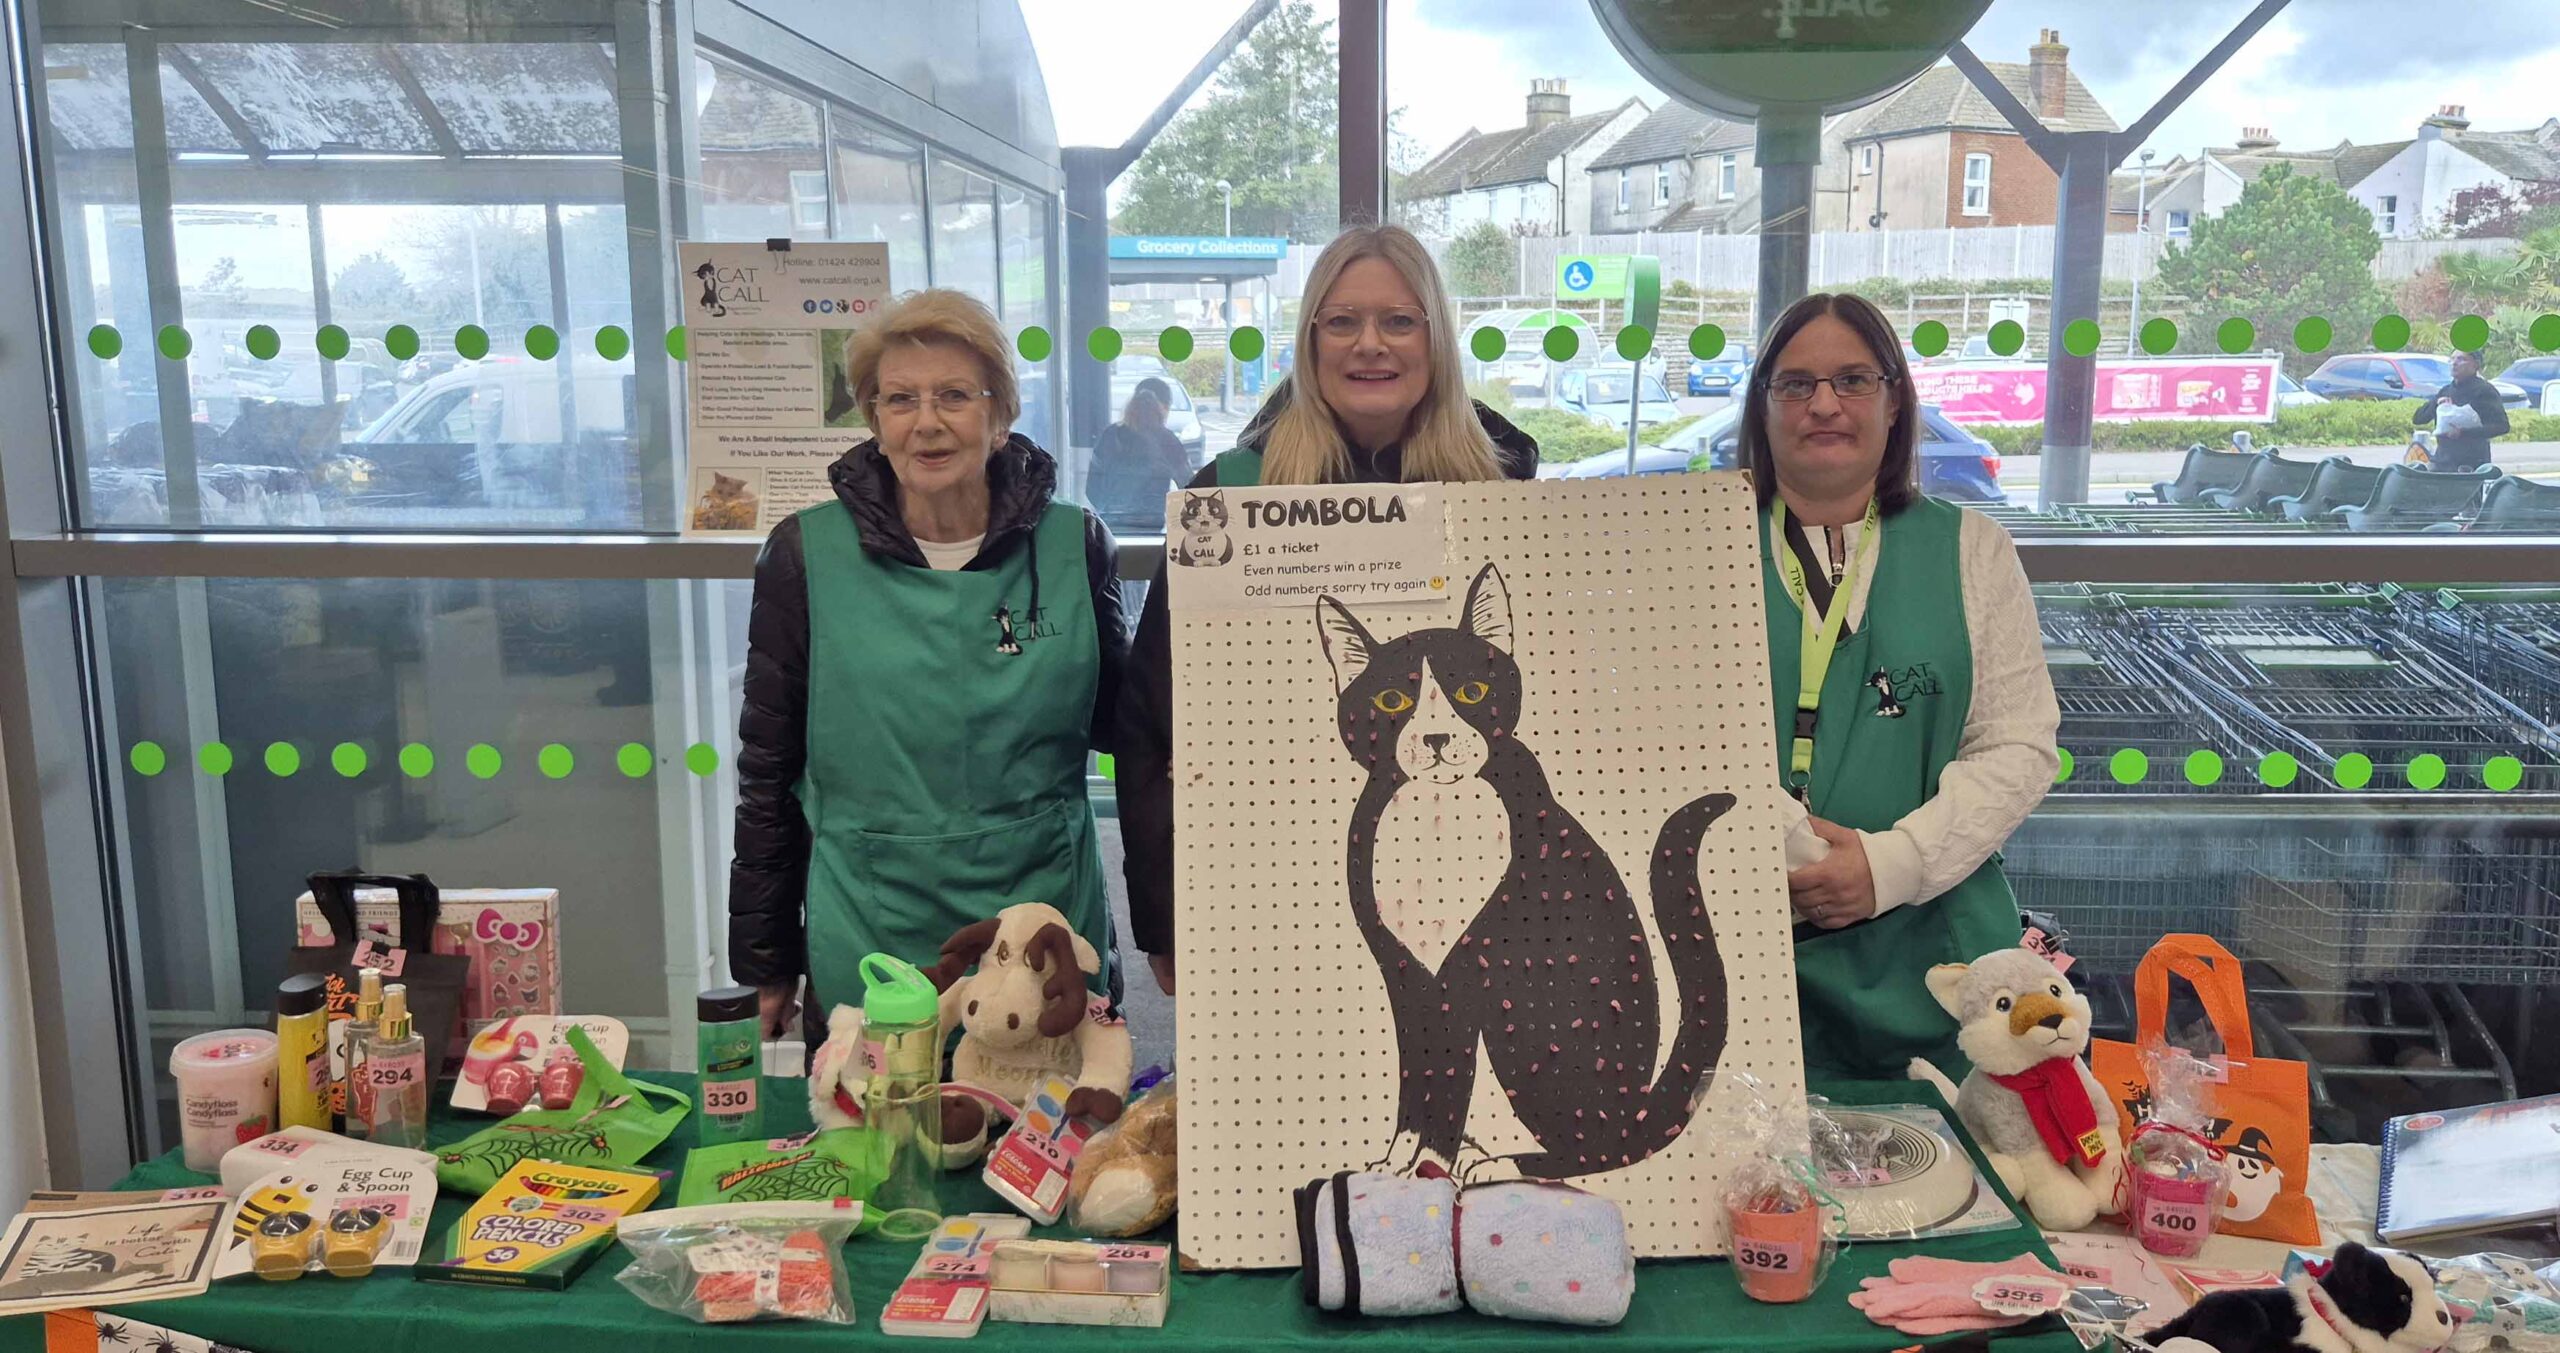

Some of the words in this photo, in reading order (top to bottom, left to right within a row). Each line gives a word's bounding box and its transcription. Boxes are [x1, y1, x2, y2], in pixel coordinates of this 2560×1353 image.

[1136, 239, 1195, 255] Grocery
[1199, 240, 1278, 255] Collections
[819, 257, 845, 267] 01424
[717, 267, 759, 283] CAT
[718, 286, 770, 302] CALL
[774, 436, 819, 444] Independent
[1241, 495, 1407, 529] TOMBOLA
[1864, 504, 1877, 532] CALL
[1197, 535, 1212, 543] CAT
[1193, 548, 1216, 558] CALL
[1243, 544, 1260, 556] £1
[1268, 546, 1276, 555] a
[1281, 542, 1320, 555] ticket
[1244, 564, 1275, 576] Even
[1277, 562, 1331, 575] numbers
[1334, 563, 1355, 573] win
[1369, 560, 1402, 574] prize
[1244, 584, 1272, 597] Odd
[1275, 581, 1329, 596] numbers
[1332, 583, 1367, 596] sorry
[1371, 580, 1391, 593] try
[1393, 578, 1427, 591] again
[1890, 662, 1931, 685] CAT
[1895, 679, 1944, 702] CALL
[373, 1067, 413, 1085] 294
[186, 1098, 239, 1111] Candyfloss
[708, 1091, 748, 1107] 330
[186, 1107, 239, 1120] Candyfloss
[259, 1138, 299, 1154] 334
[1025, 1133, 1059, 1159] 210
[341, 1168, 373, 1184] Egg
[378, 1168, 413, 1181] Cup
[531, 1171, 621, 1193] Crayola
[337, 1181, 350, 1193] &
[355, 1181, 411, 1195] Spoon
[561, 1208, 608, 1222] 302
[2151, 1213, 2197, 1232] 400
[128, 1223, 163, 1237] Life
[476, 1213, 585, 1236] COLORED
[121, 1236, 164, 1245] better
[161, 1237, 191, 1246] with
[471, 1226, 570, 1249] PENCILS
[486, 1248, 514, 1261] 36
[1741, 1248, 1788, 1269] 392
[934, 1262, 977, 1272] 274
[2067, 1267, 2099, 1279] 86
[1993, 1288, 2044, 1303] 396
